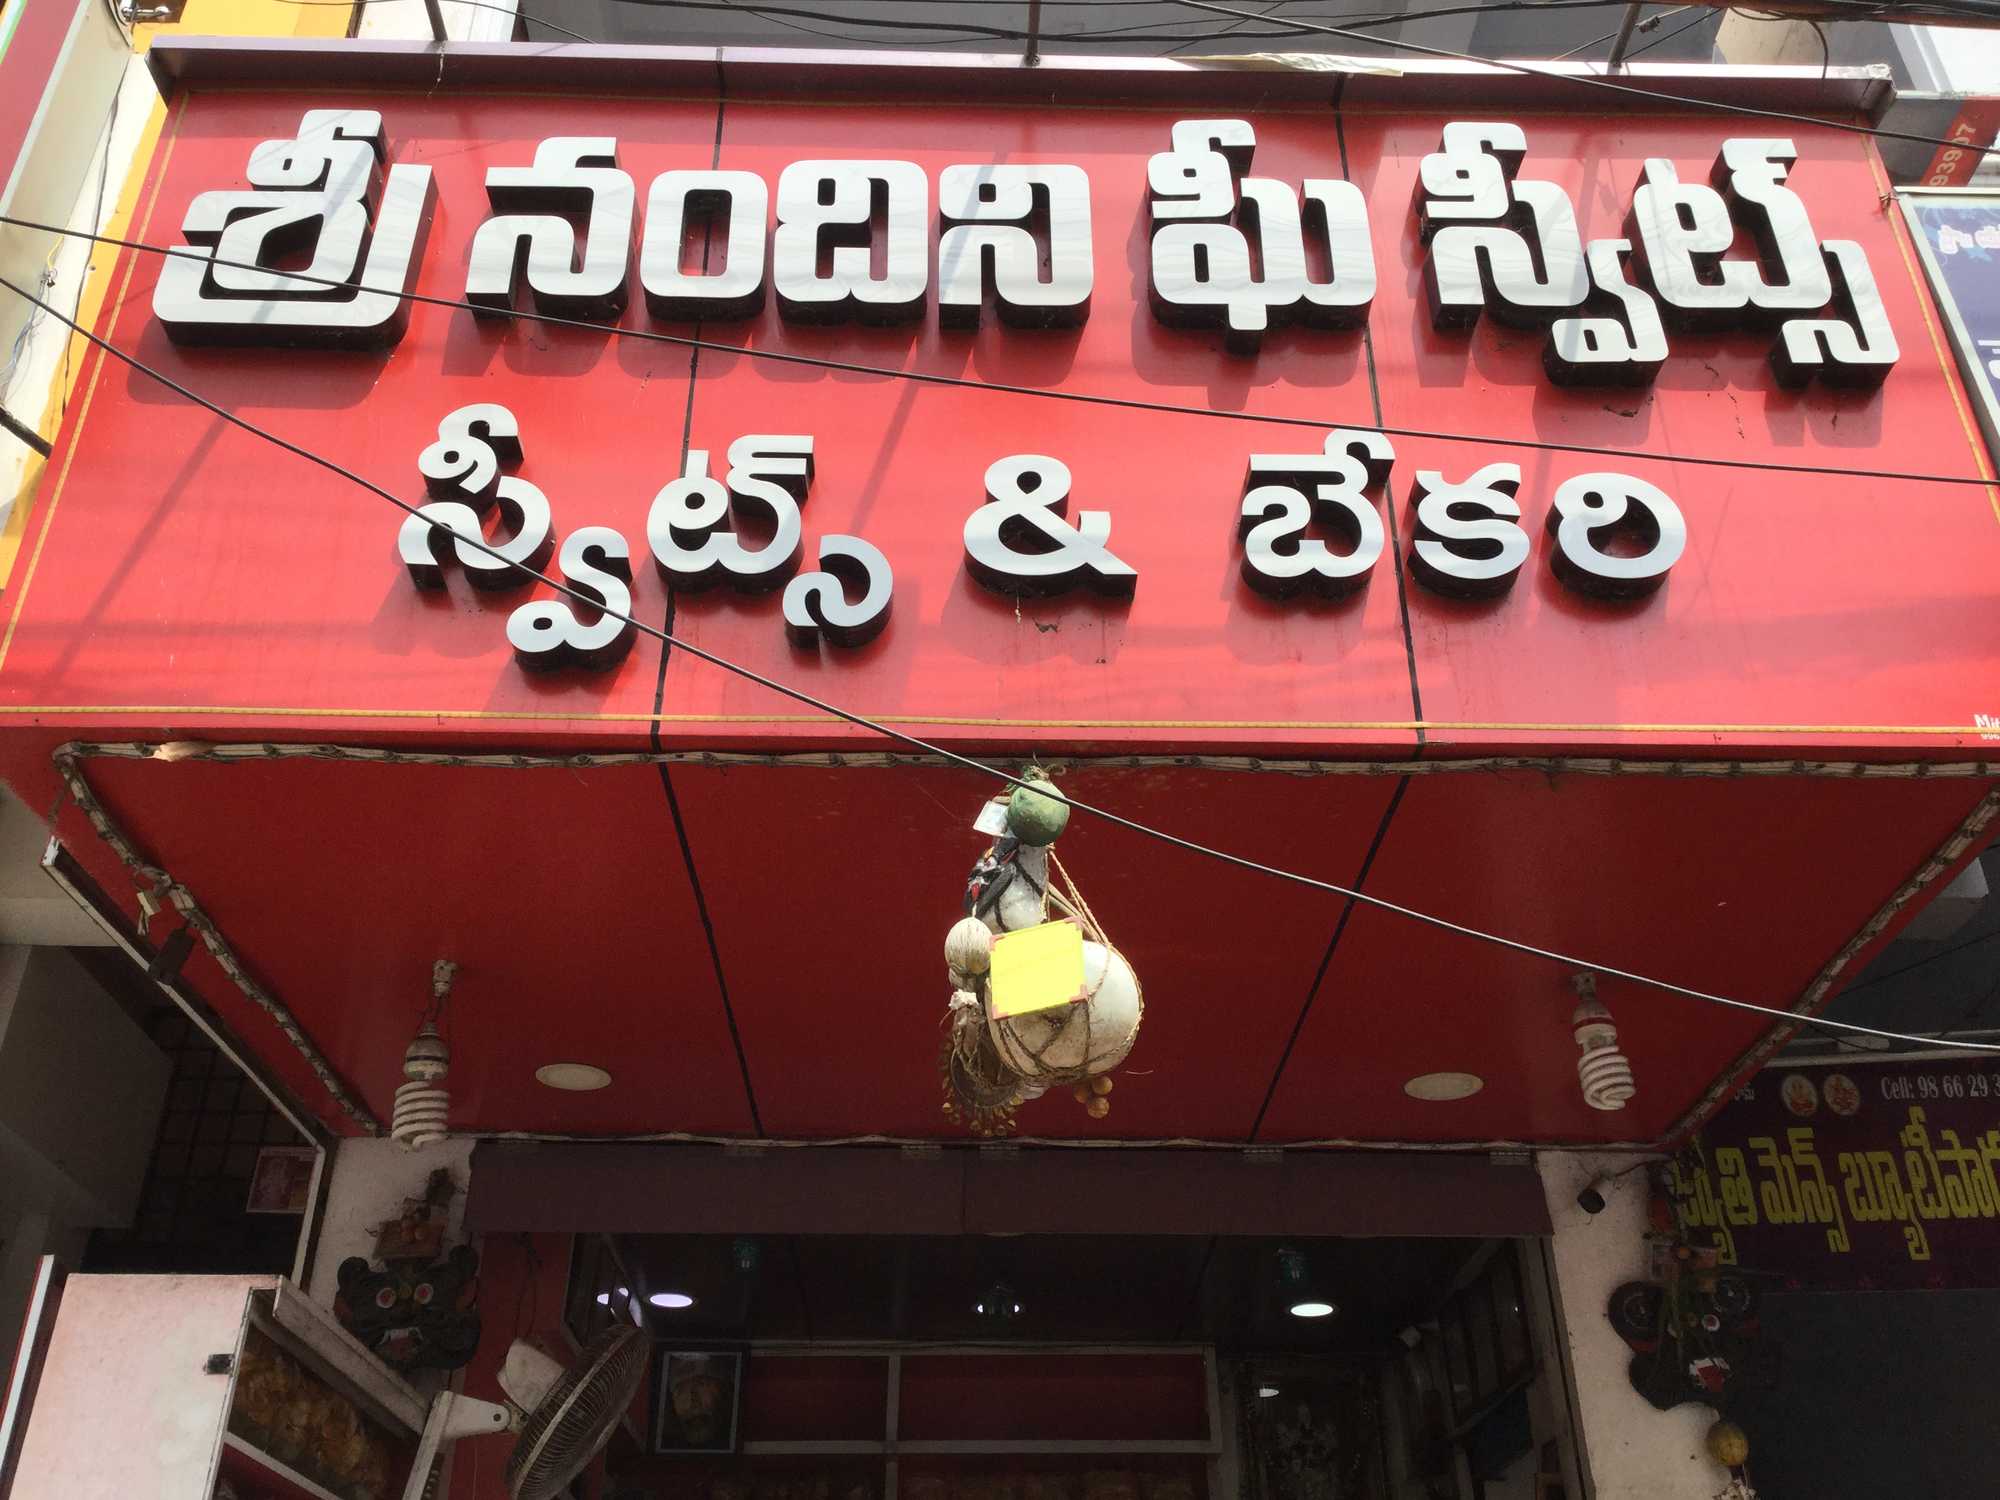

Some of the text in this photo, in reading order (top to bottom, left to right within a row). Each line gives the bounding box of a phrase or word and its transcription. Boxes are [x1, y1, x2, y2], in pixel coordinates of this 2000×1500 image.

[152, 109, 1902, 366] శ్రీ నందిని ఘీ స్వీట్స్
[398, 403, 1688, 655] స్వీట్స్ & బేకరి
